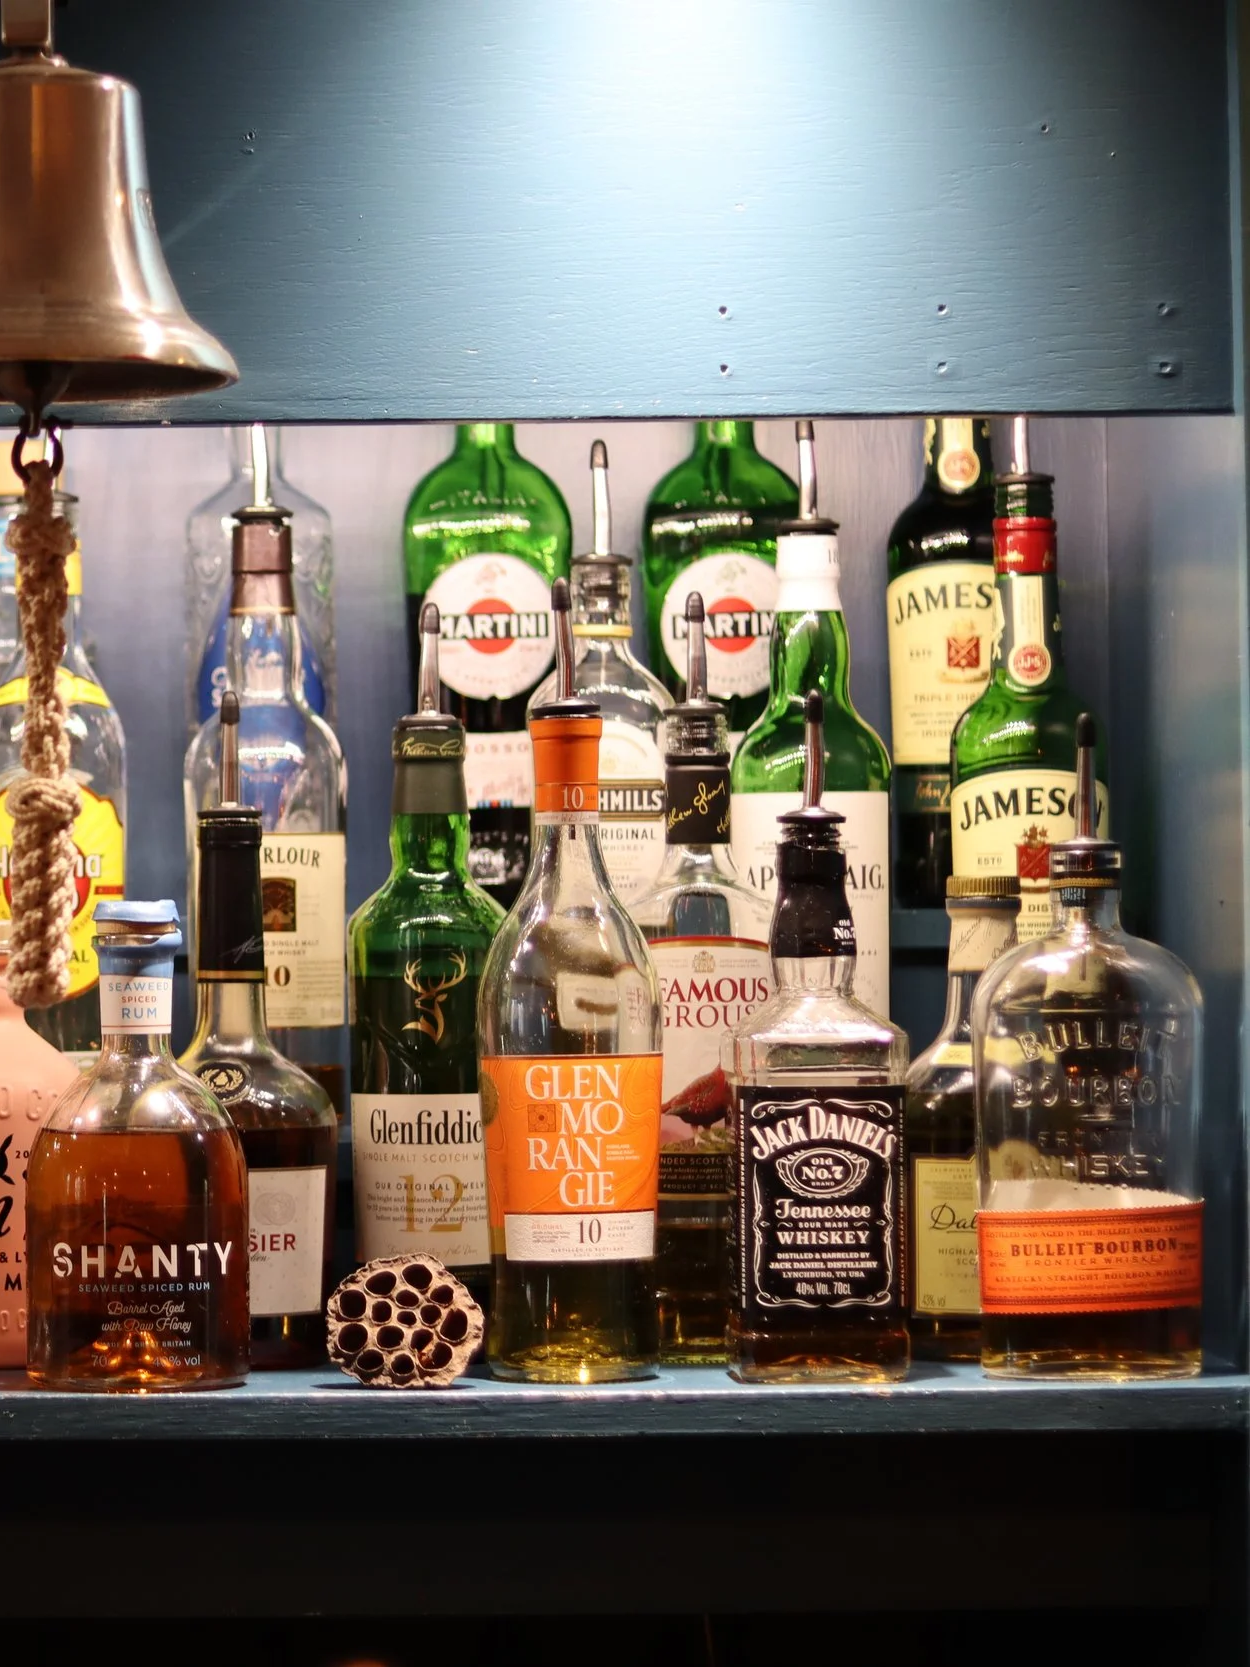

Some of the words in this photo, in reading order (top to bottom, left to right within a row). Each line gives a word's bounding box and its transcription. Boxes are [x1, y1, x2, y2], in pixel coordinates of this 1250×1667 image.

[561, 786, 584, 809] 10
[108, 982, 169, 992] SEAWEED
[121, 995, 157, 1003] SPICED
[121, 1007, 158, 1020] RUM
[525, 1064, 621, 1101] GLEN
[560, 1100, 625, 1135] MO
[750, 1115, 807, 1160] JACK
[808, 1106, 897, 1159] DANIEL'S
[391, 1152, 417, 1163] MALT
[421, 1152, 469, 1164] SCOTCH
[526, 1136, 602, 1172] RAN
[810, 1157, 833, 1165] Old
[375, 1181, 391, 1190] OUR
[396, 1183, 451, 1191] ORIGINAL
[559, 1171, 615, 1207] GIE
[398, 1174, 464, 1233] 12
[774, 1198, 871, 1220] Tennessee
[578, 1217, 602, 1244] 10
[798, 1221, 821, 1229] SOUR
[824, 1221, 849, 1229] MASH
[776, 1231, 870, 1245] WHISKEY
[1011, 1242, 1085, 1257] BULLEIT
[1094, 1237, 1177, 1255] BOURBON
[52, 1240, 233, 1279] SHANTY
[776, 1252, 811, 1260] DISTILLED
[1025, 1257, 1097, 1267] FRONTIER
[1104, 1254, 1166, 1265] WHISKEY
[769, 1261, 792, 1270] JACK
[827, 1261, 878, 1269] DISTILLERY
[836, 1271, 847, 1279] TN
[849, 1271, 865, 1279] USA
[995, 1274, 1043, 1283] KENTUCKY
[1047, 1273, 1098, 1282] STRAIGHT
[1105, 1271, 1151, 1280] BOURBON
[78, 1283, 135, 1293] SEAWEED
[140, 1283, 183, 1293] SPICED
[188, 1281, 211, 1291] RUM
[795, 1281, 815, 1296] 40%
[833, 1281, 851, 1296] 70CL
[107, 1300, 149, 1315] Barrel
[150, 1300, 186, 1316] Aged
[101, 1317, 123, 1332] with
[124, 1318, 154, 1333] Raw
[155, 1317, 192, 1333] Honey
[162, 1339, 192, 1348] BRITAIN
[184, 1355, 201, 1367] vol
